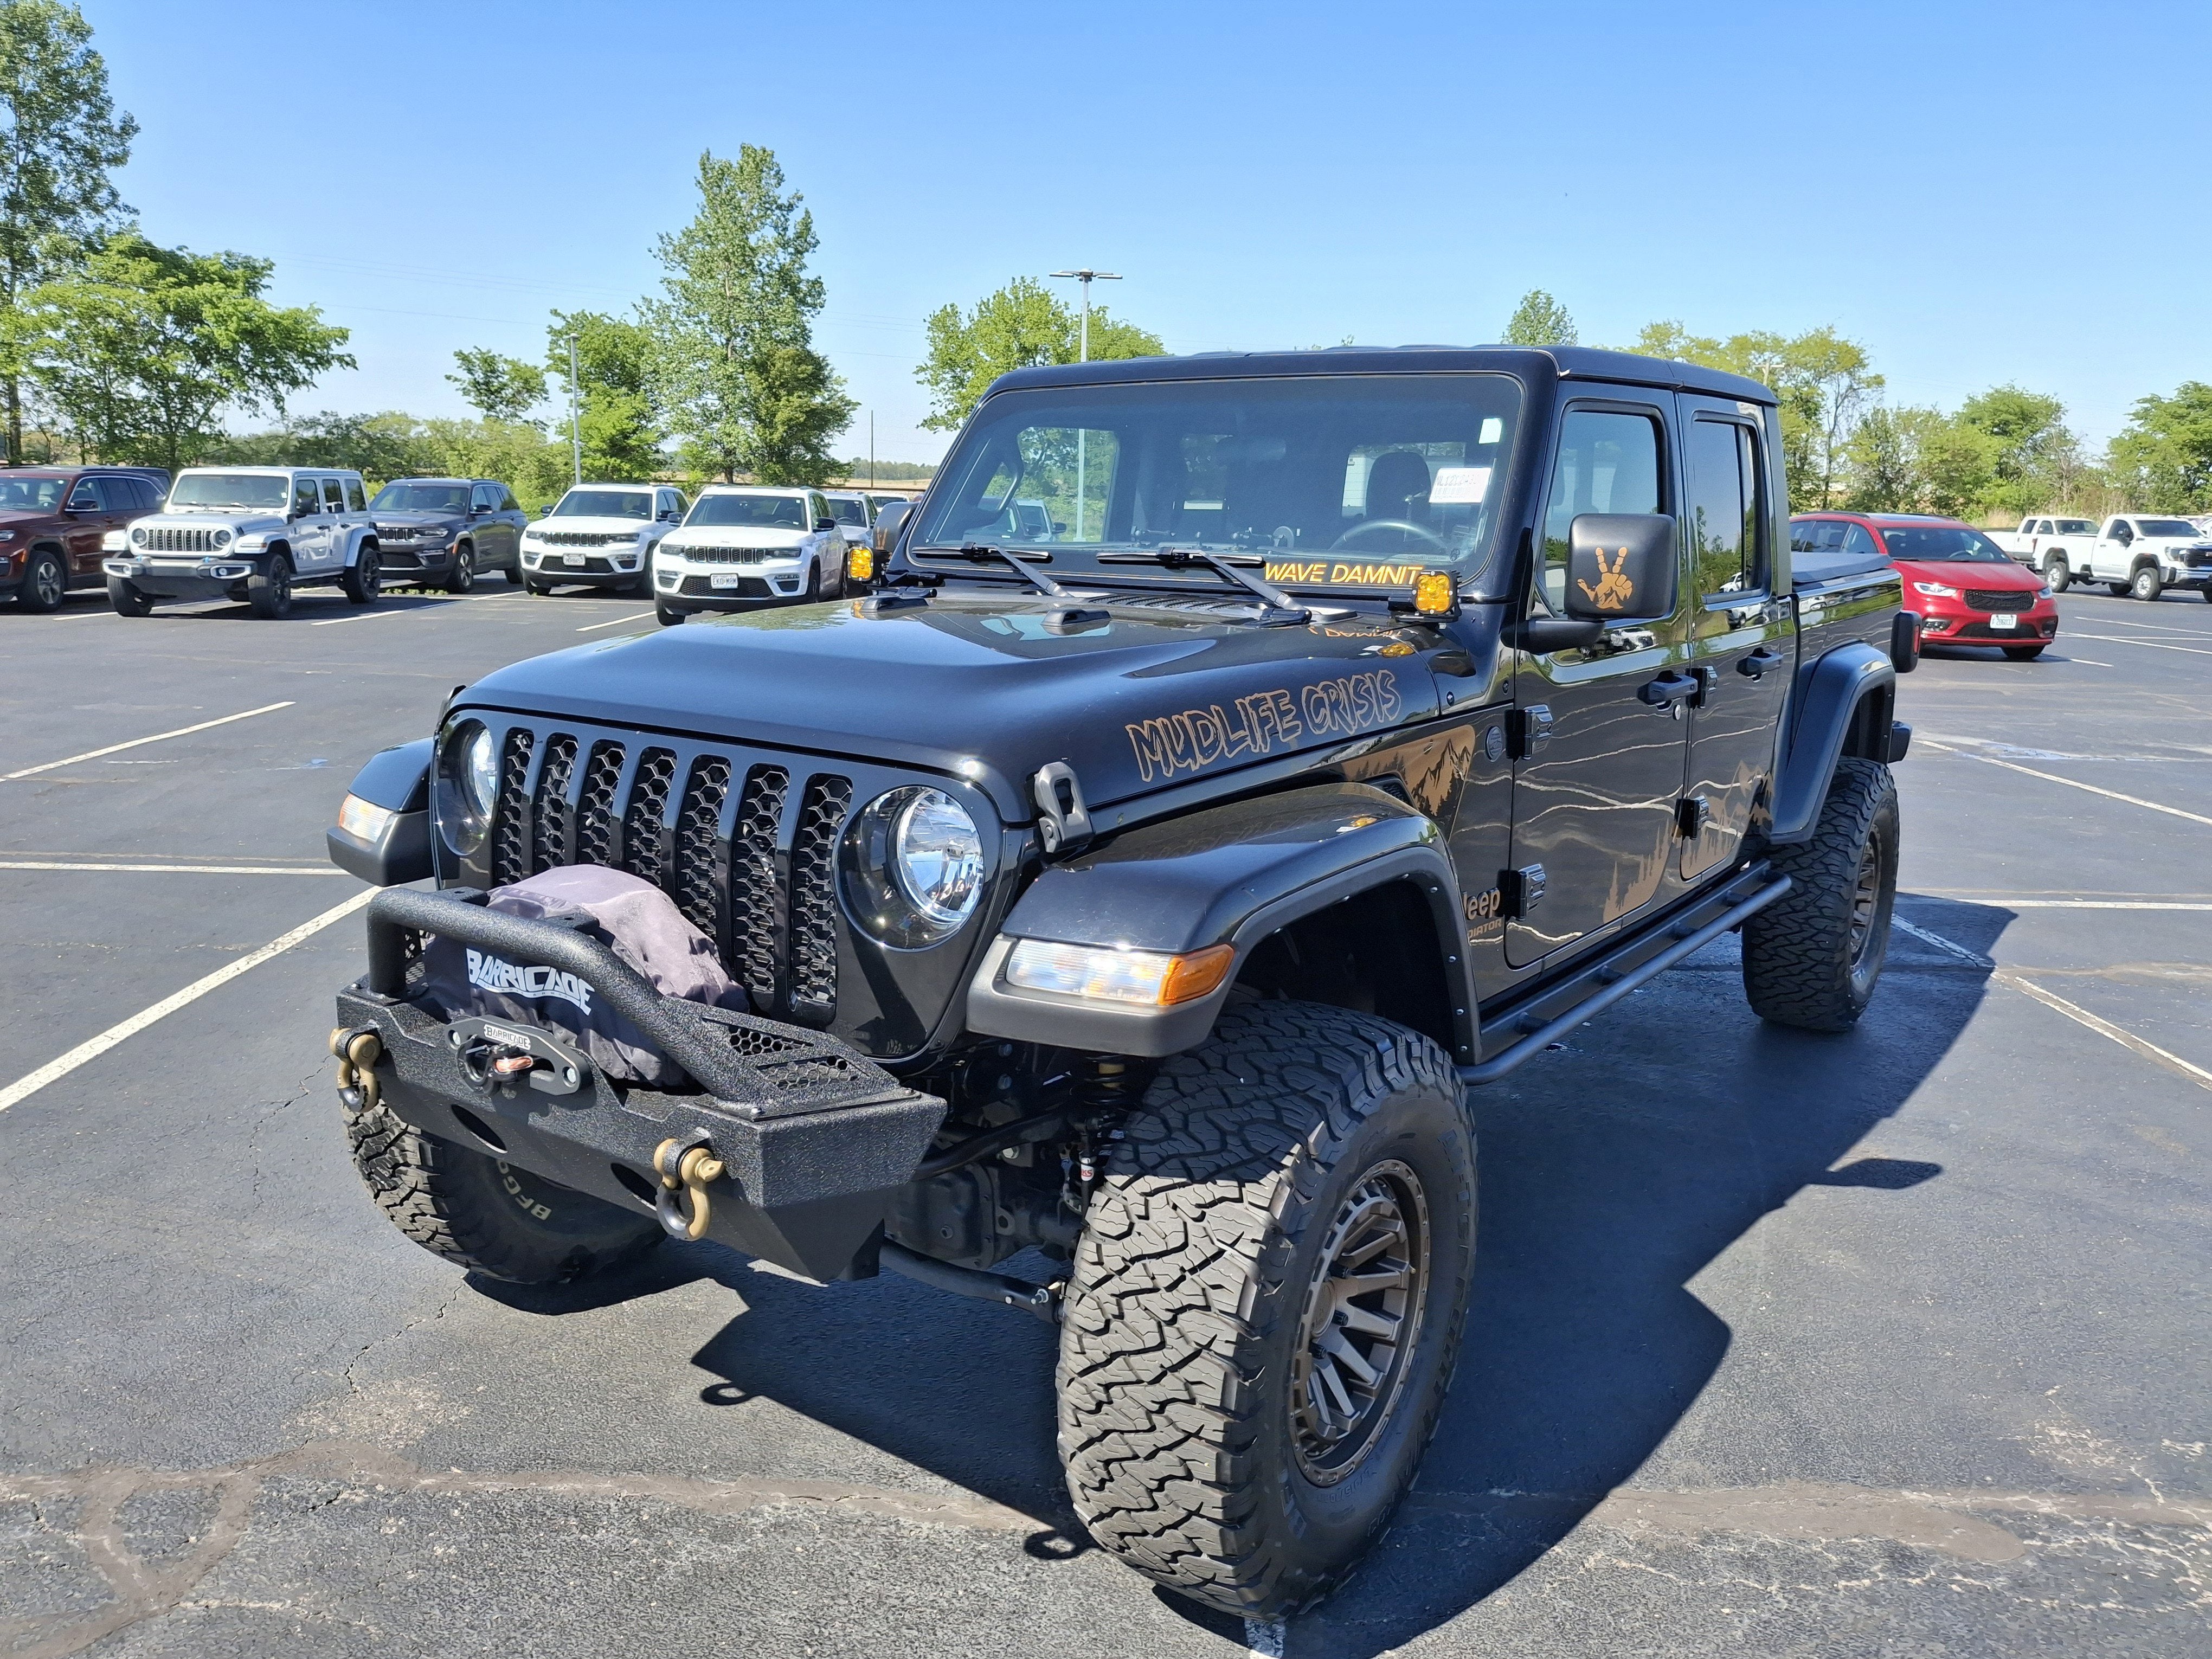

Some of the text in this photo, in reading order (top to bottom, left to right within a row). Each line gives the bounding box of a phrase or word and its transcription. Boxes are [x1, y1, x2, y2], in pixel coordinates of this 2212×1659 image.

[1264, 563, 1423, 584] WAVE DAMNIT
[1125, 669, 1401, 782] MUDLIFE CRISIS
[466, 948, 595, 1016] BARRICADE
[486, 1026, 530, 1048] BARRICADE
